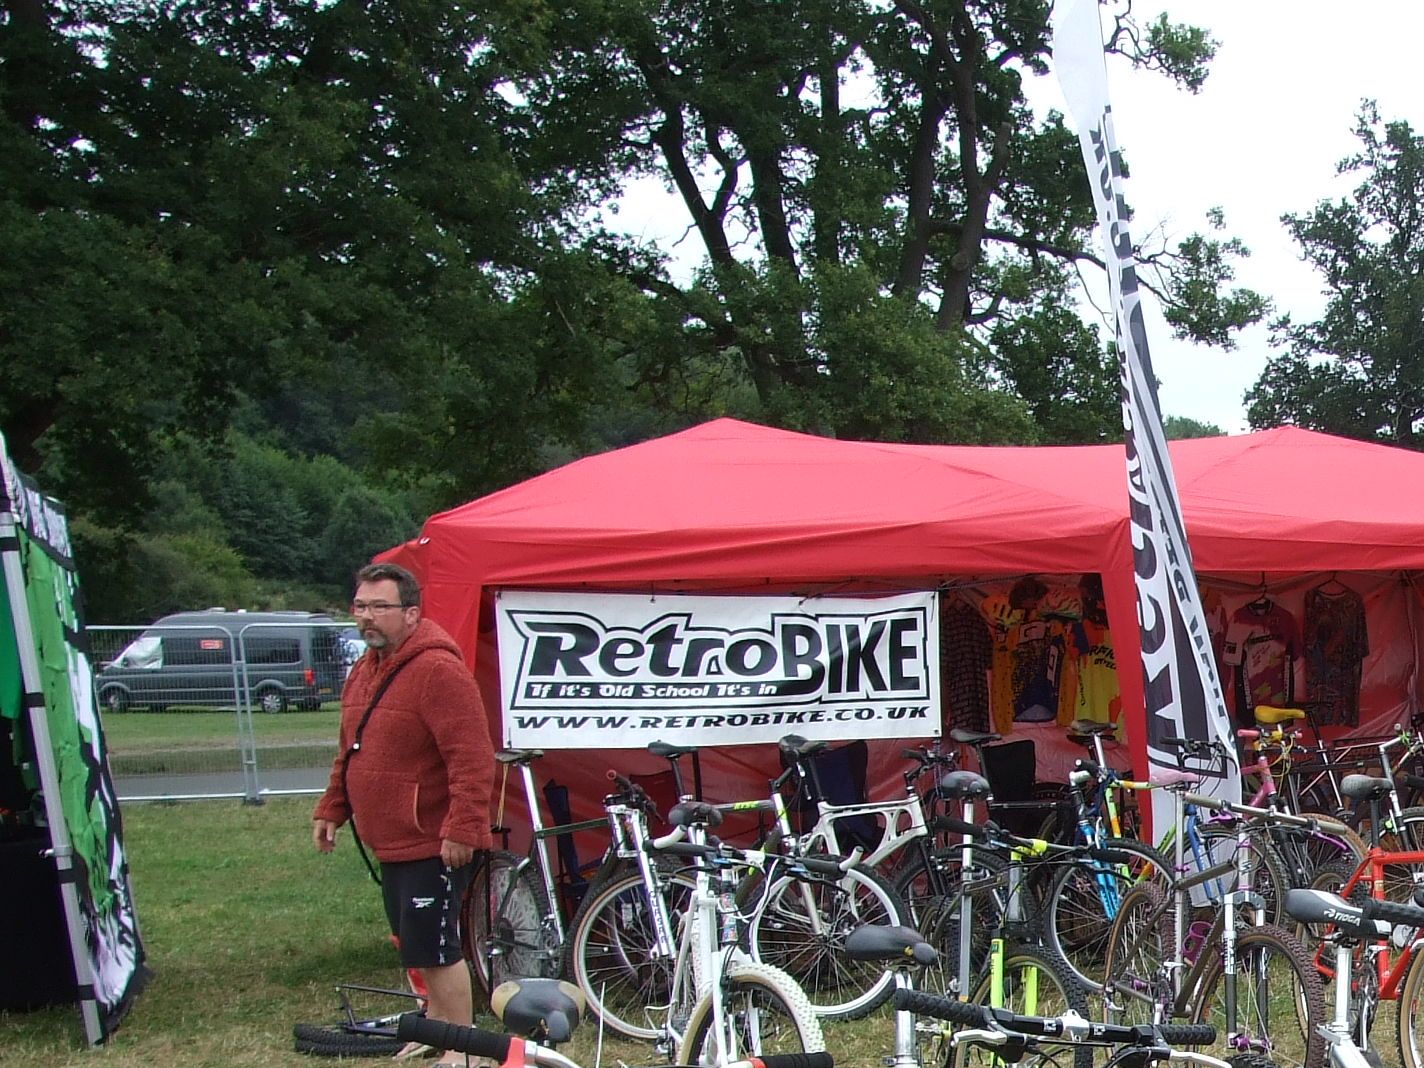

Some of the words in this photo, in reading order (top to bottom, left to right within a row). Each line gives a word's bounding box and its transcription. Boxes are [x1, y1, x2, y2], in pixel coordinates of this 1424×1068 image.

[523, 618, 920, 696] RetroBIKE
[559, 683, 591, 697] it's
[599, 684, 634, 698] Old
[642, 683, 709, 698] School
[758, 683, 777, 696] in
[513, 706, 931, 729] WWW.RETROBIKE.CO.UK
